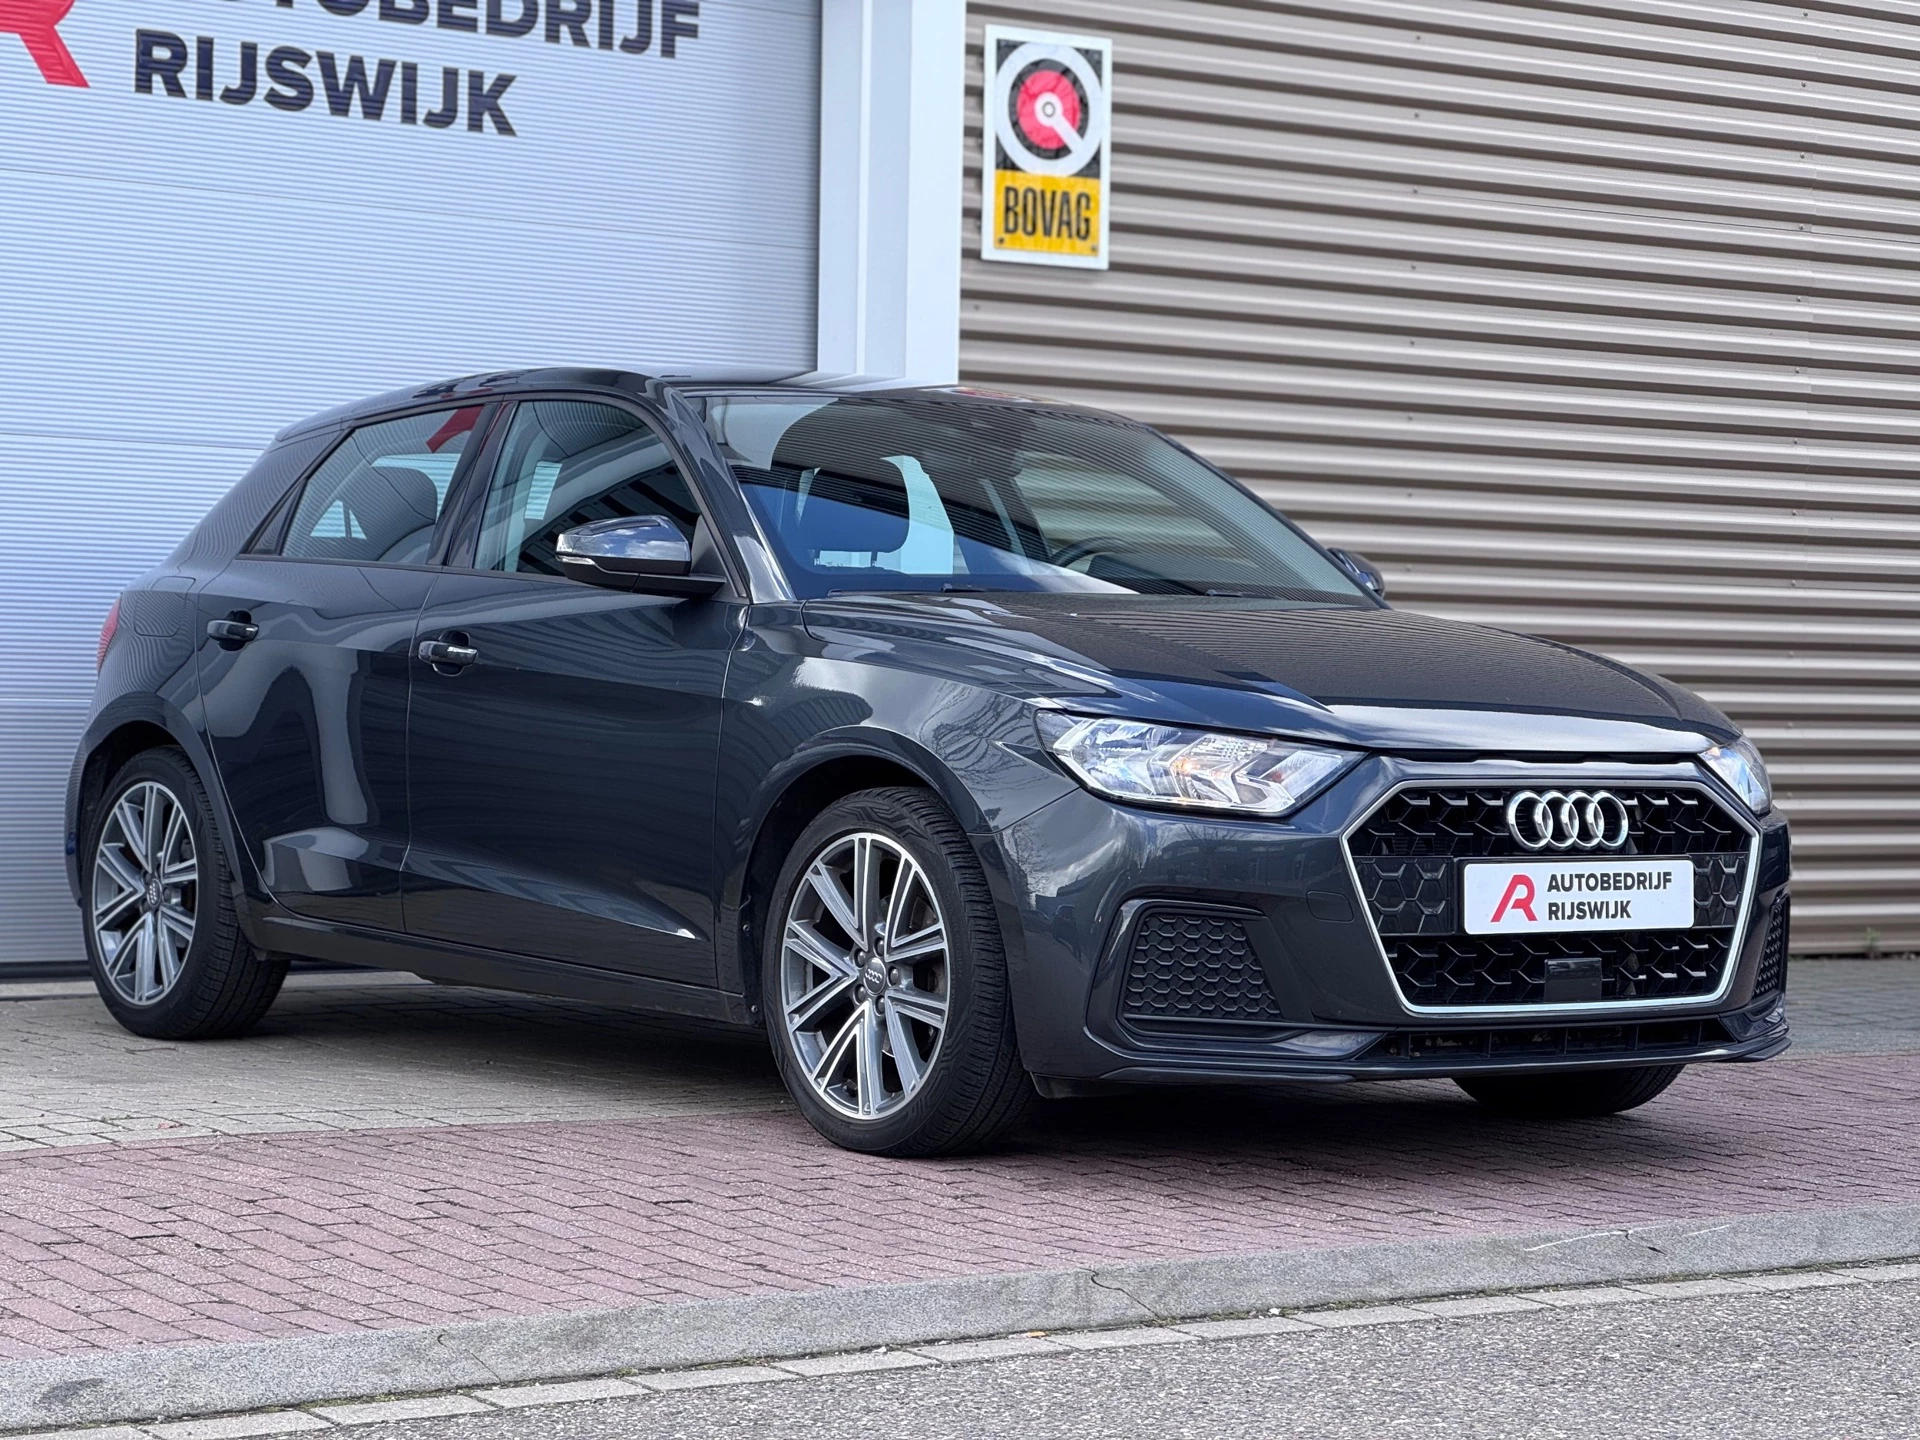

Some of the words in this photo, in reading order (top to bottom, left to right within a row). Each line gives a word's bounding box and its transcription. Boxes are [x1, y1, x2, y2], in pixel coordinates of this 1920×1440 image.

[134, 28, 517, 137] RIJSWIJK
[1004, 186, 1091, 240] BOVAG
[1547, 871, 1672, 892] AUTOBEDRIJF
[1548, 900, 1632, 920] RIJSWIJK
